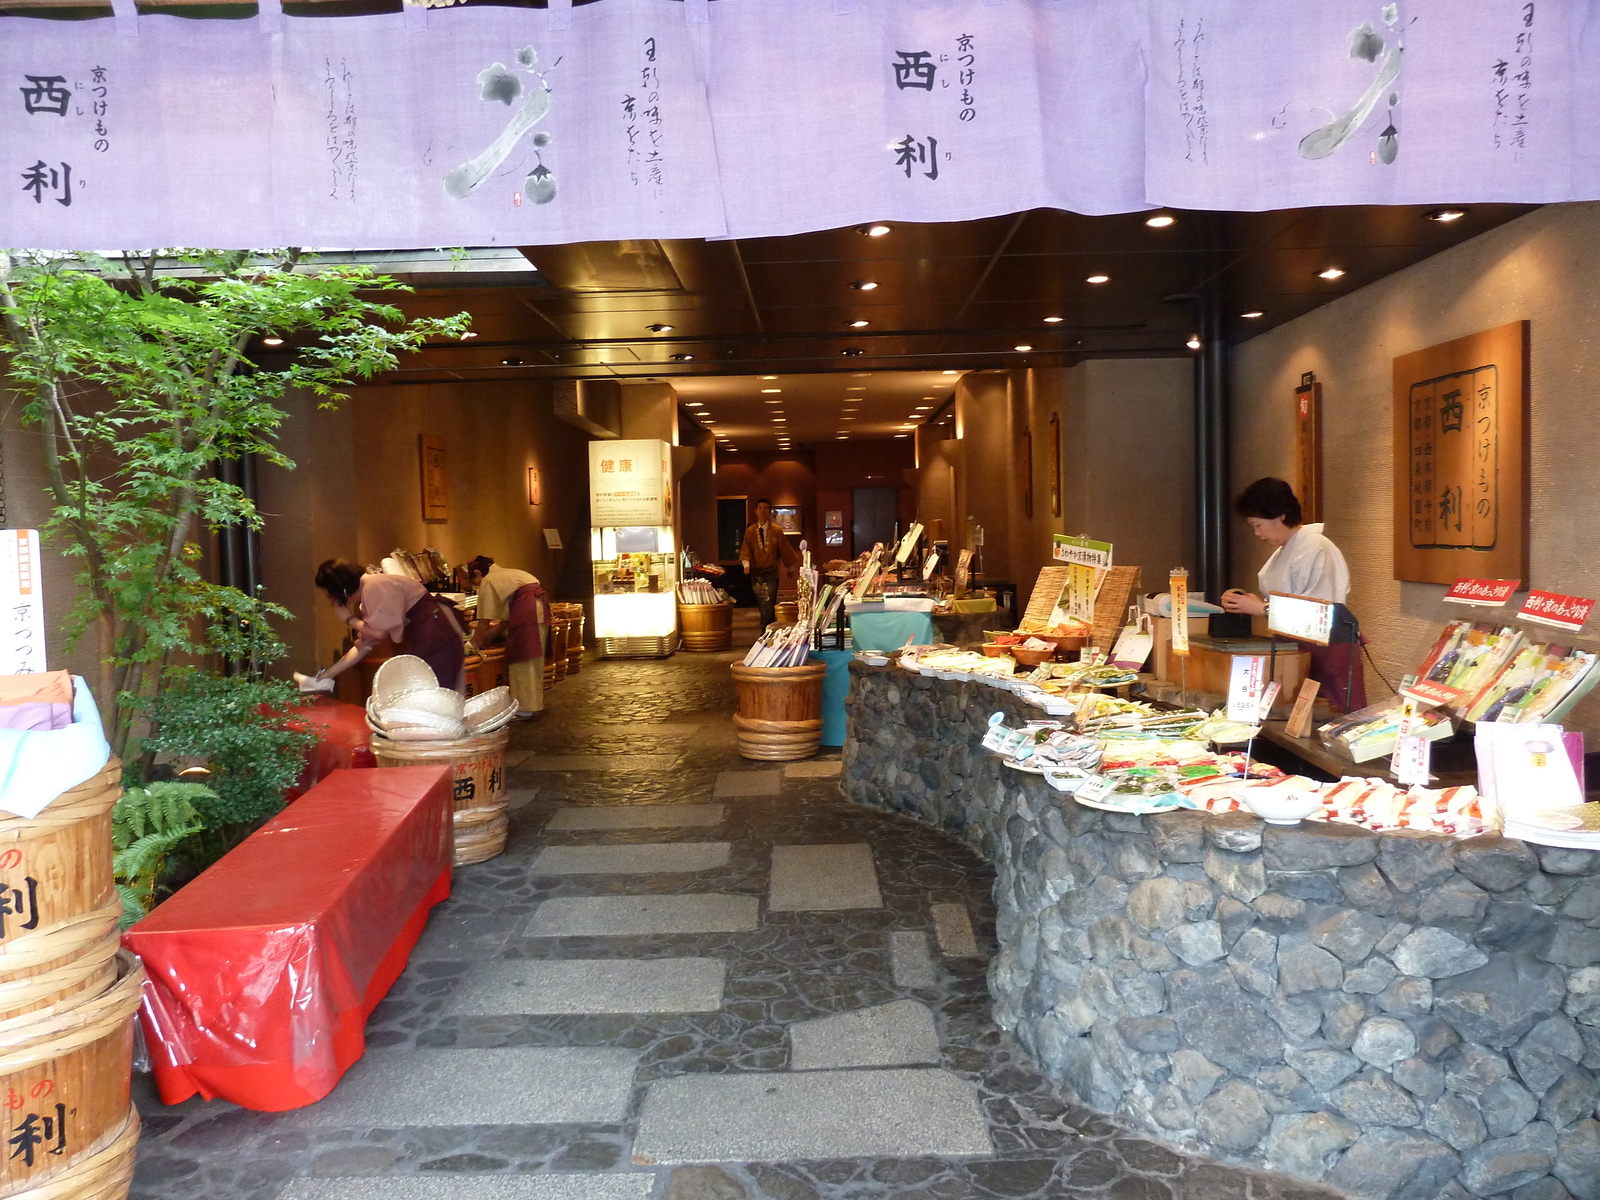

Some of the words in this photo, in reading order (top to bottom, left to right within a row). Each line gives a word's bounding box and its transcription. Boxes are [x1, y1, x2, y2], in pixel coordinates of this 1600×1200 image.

[91, 65, 109, 153] 京つけもの
[892, 49, 938, 181] 西利
[956, 33, 976, 122] 京つけもの
[20, 75, 72, 207] 西利
[600, 459, 632, 473] 健康
[1439, 388, 1463, 533] 西利
[1477, 383, 1492, 518] 京つけもの
[3, 1079, 54, 1110] もの
[8, 1103, 66, 1167] 利
